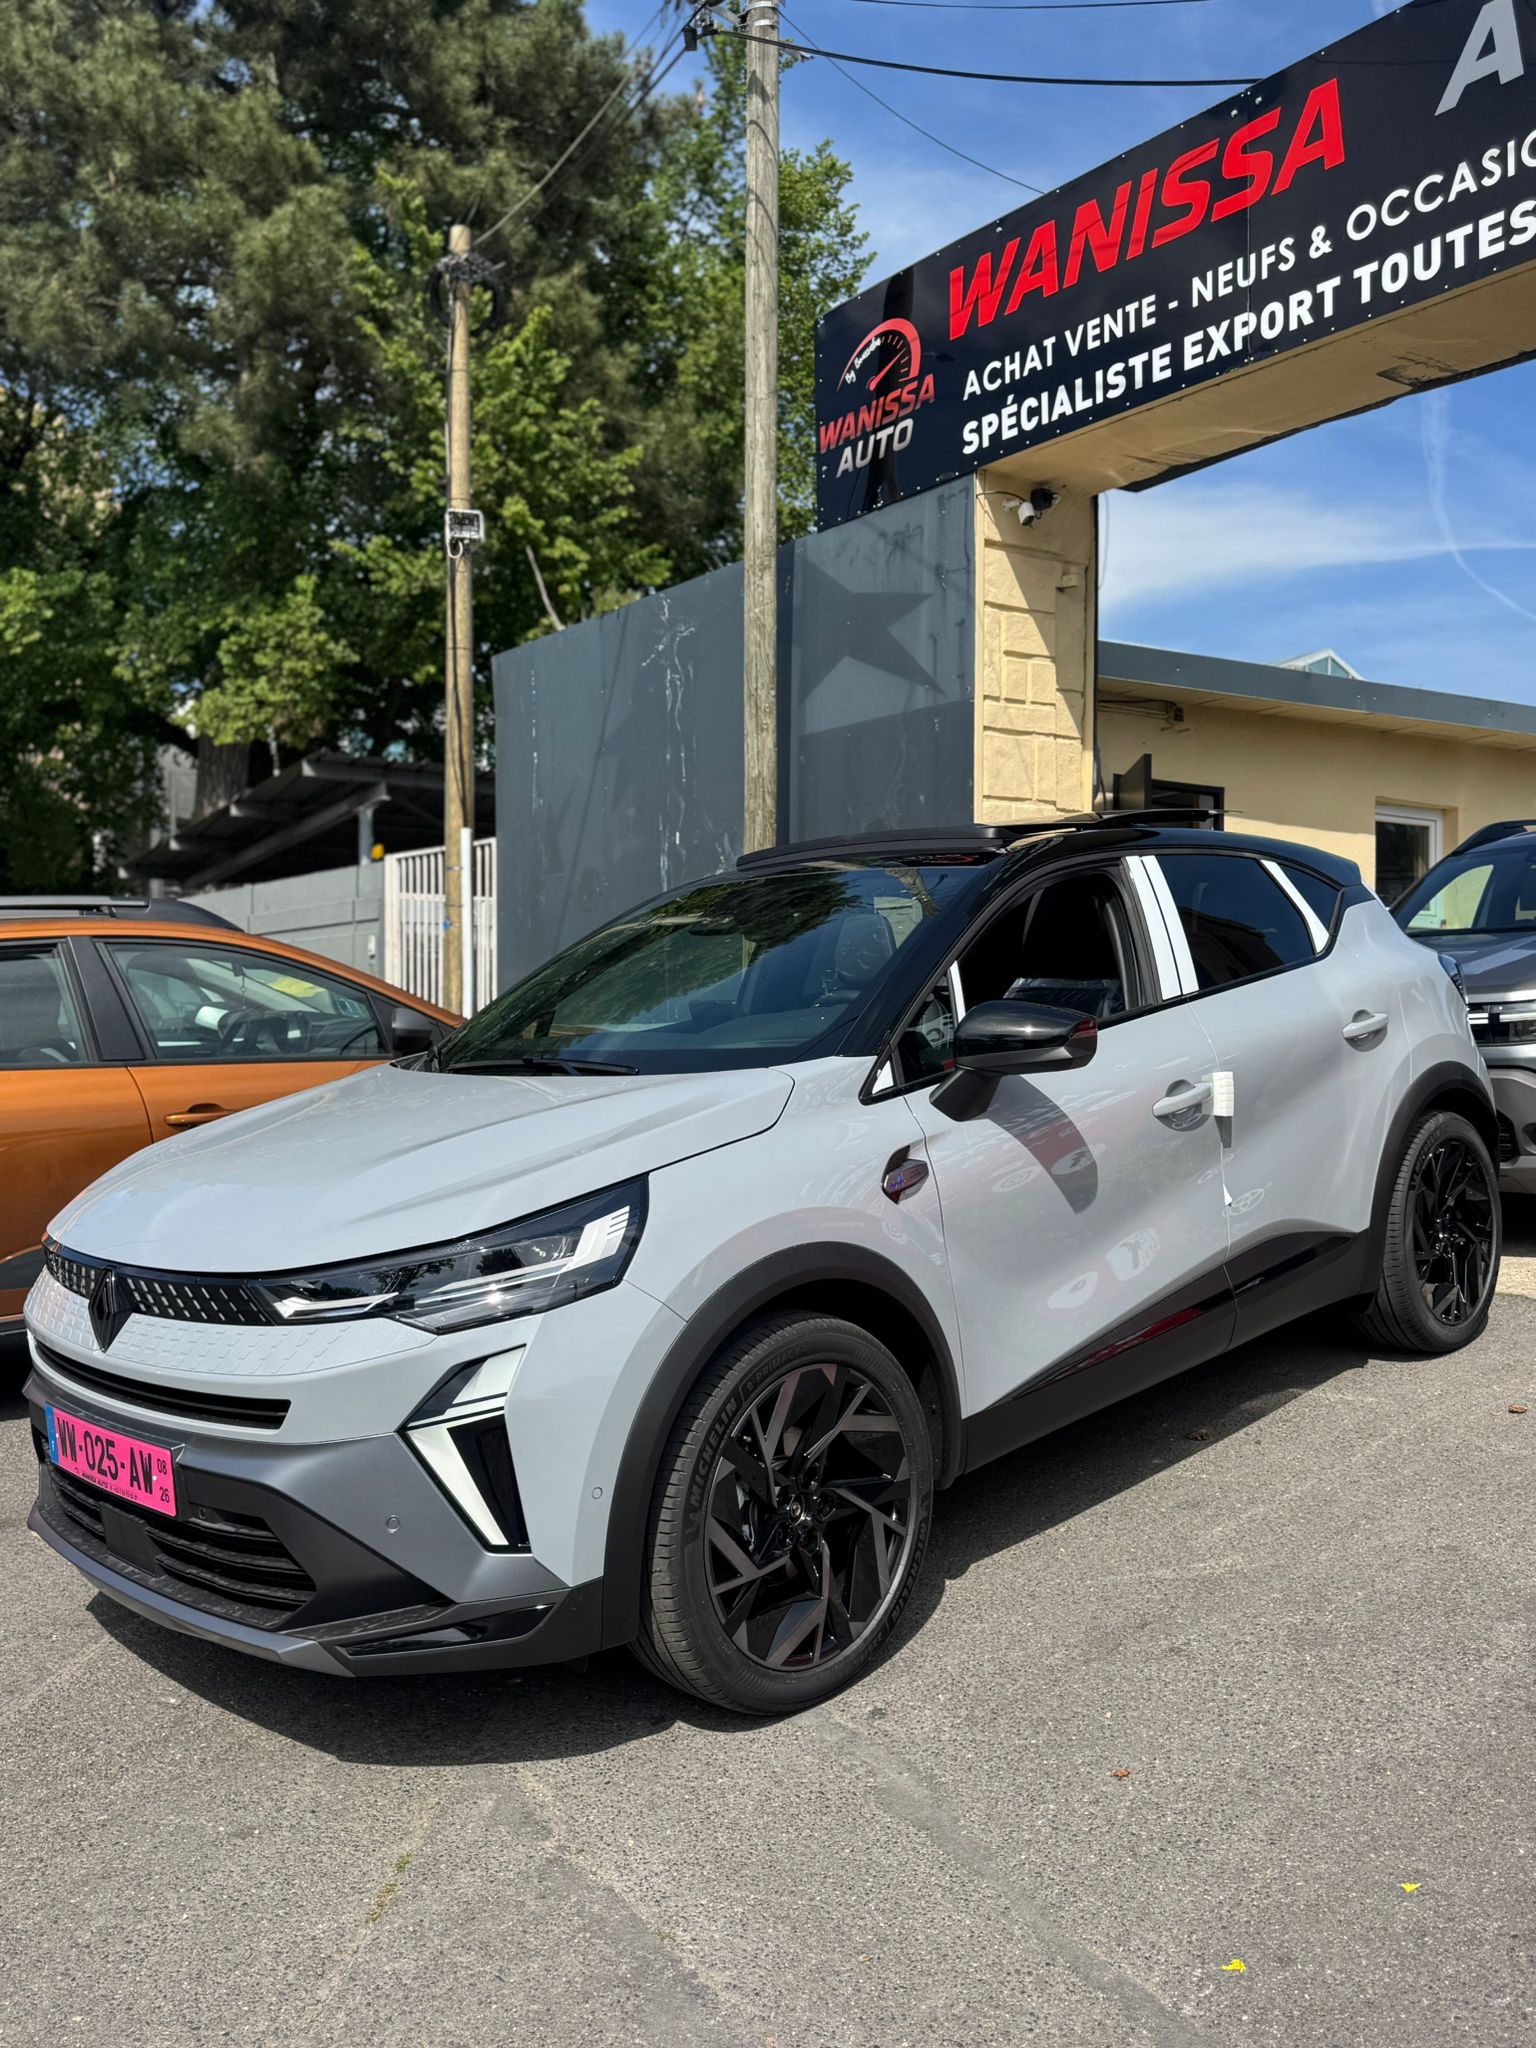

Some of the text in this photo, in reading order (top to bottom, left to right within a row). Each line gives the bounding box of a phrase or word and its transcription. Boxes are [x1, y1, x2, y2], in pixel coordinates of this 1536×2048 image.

[949, 78, 1345, 341] WANISSA
[962, 199, 1536, 455] SPÉCIALISTE EXPORT TOUTES
[963, 336, 1056, 401] ACHAT
[1065, 295, 1156, 356] VENTE
[1191, 237, 1296, 307] NEUFS
[1309, 225, 1333, 259] &
[819, 373, 936, 455] WANISSA
[836, 418, 914, 479] AUTO
[157, 1458, 168, 1476] 08
[159, 1486, 170, 1504] 26
[689, 1396, 738, 1509] MICHELIN
